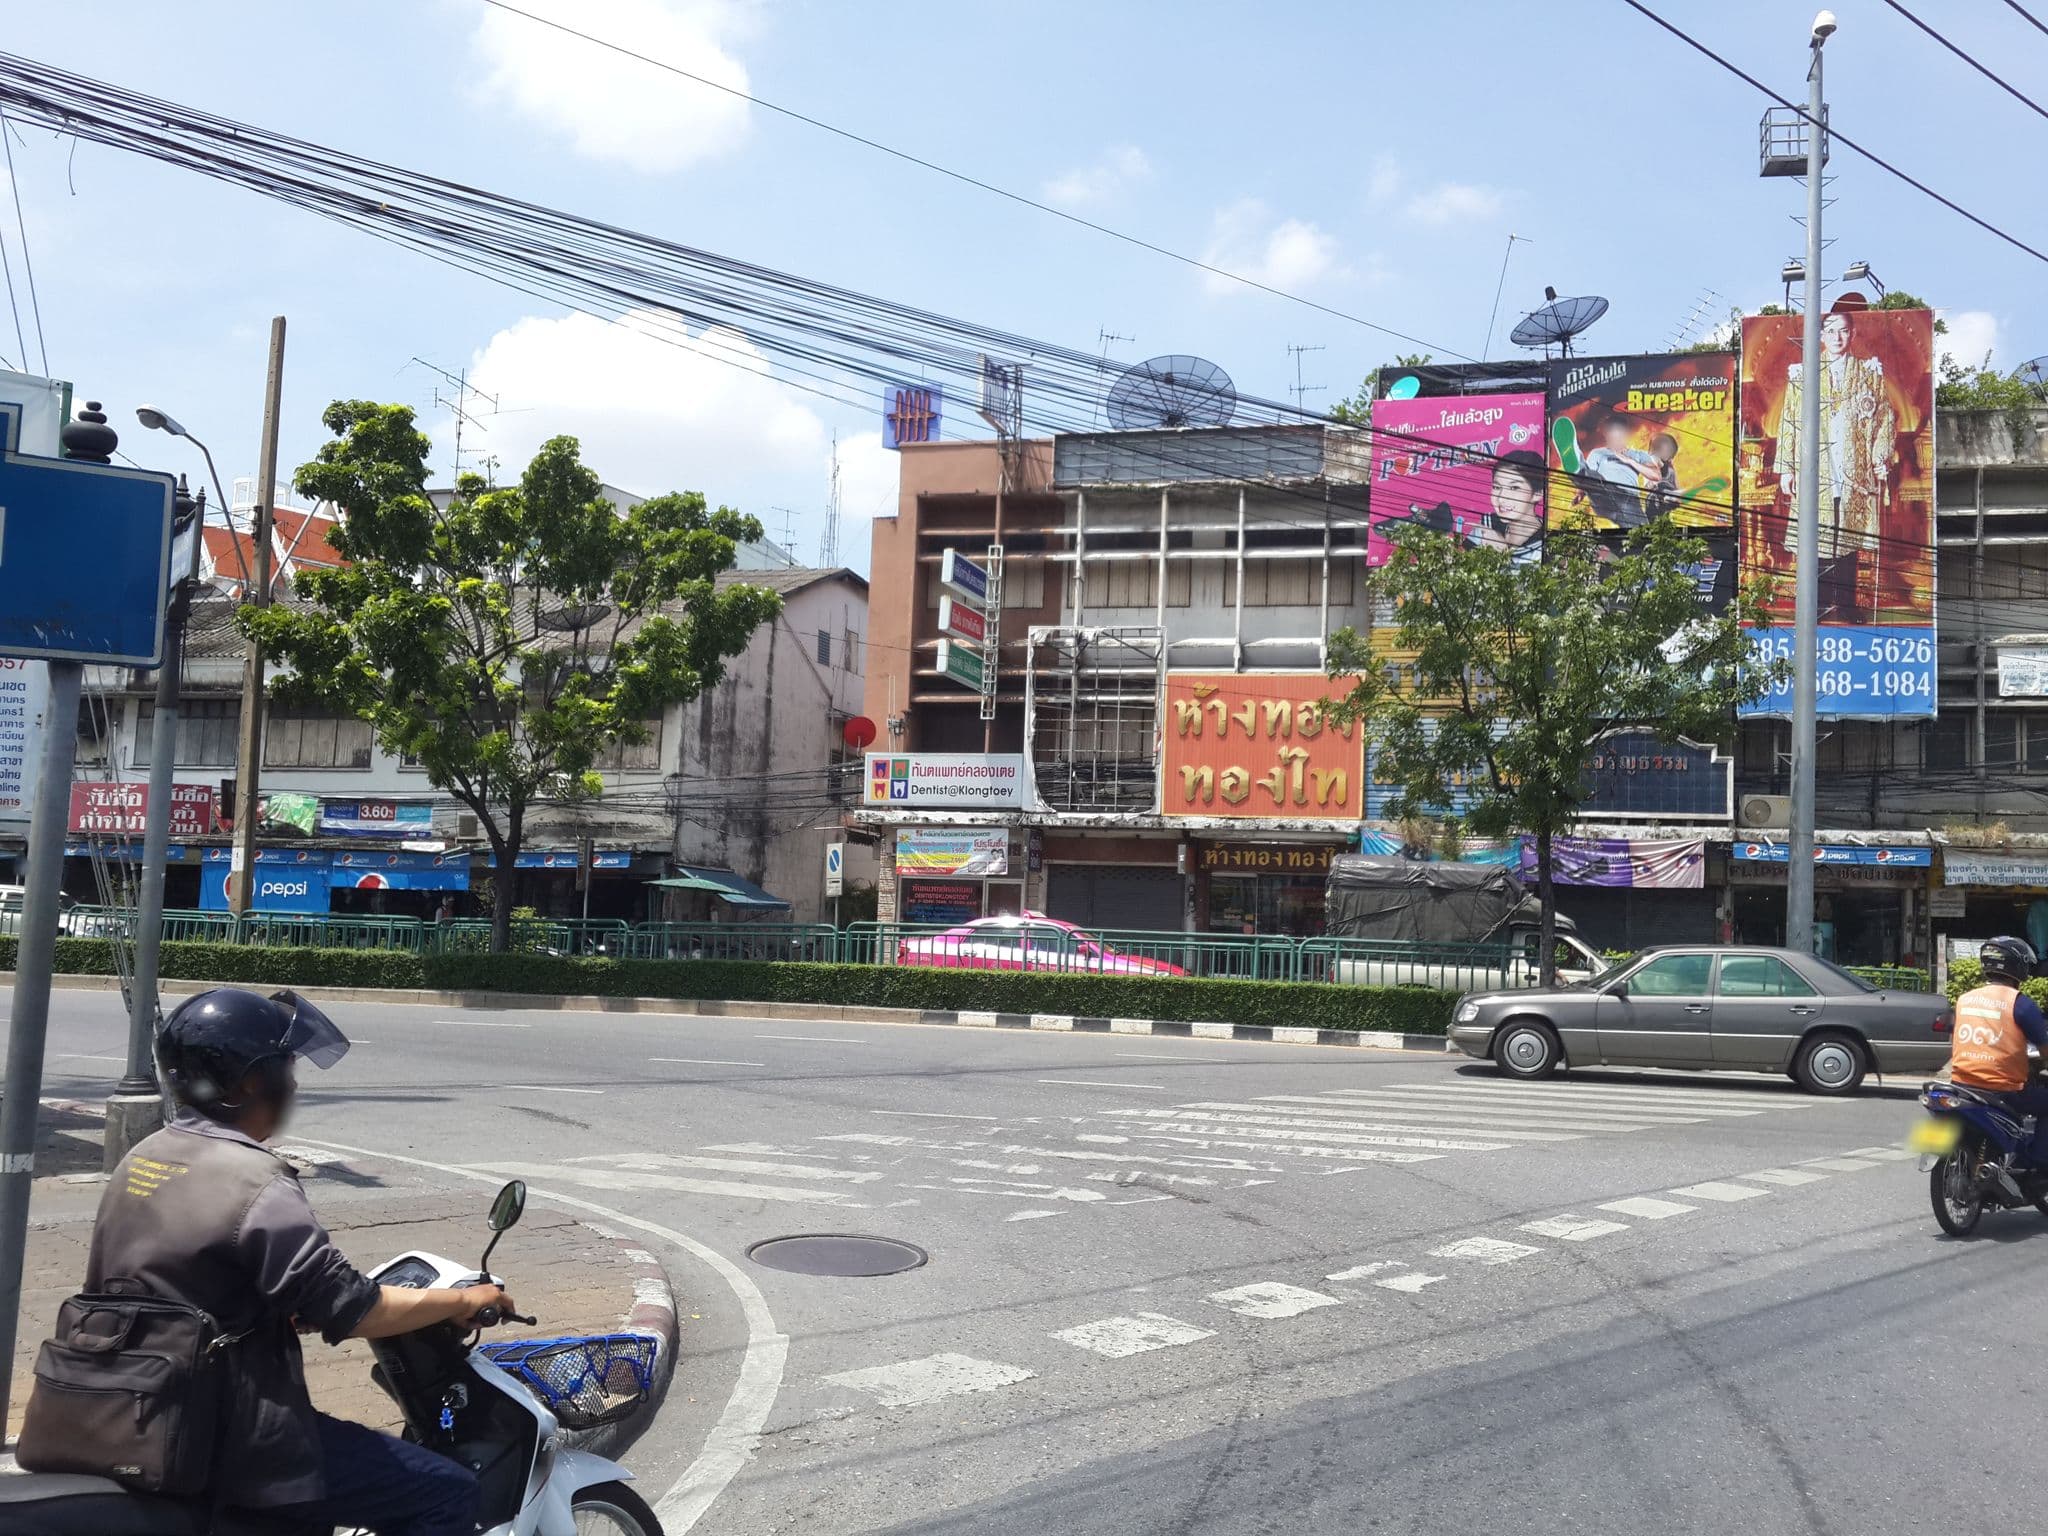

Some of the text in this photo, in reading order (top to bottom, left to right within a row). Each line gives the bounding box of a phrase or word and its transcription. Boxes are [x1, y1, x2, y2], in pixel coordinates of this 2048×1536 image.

[1627, 388, 1726, 412] Breaker
[1745, 638, 1932, 663] 08588-5626
[911, 762, 1015, 778] ทันตแพทย์คลองเตย
[1178, 746, 1348, 804] ทองไท
[911, 785, 1014, 797] Dentist@Klongtoey
[1204, 843, 1284, 866] ห้างทอง
[261, 881, 307, 898] pepsi
